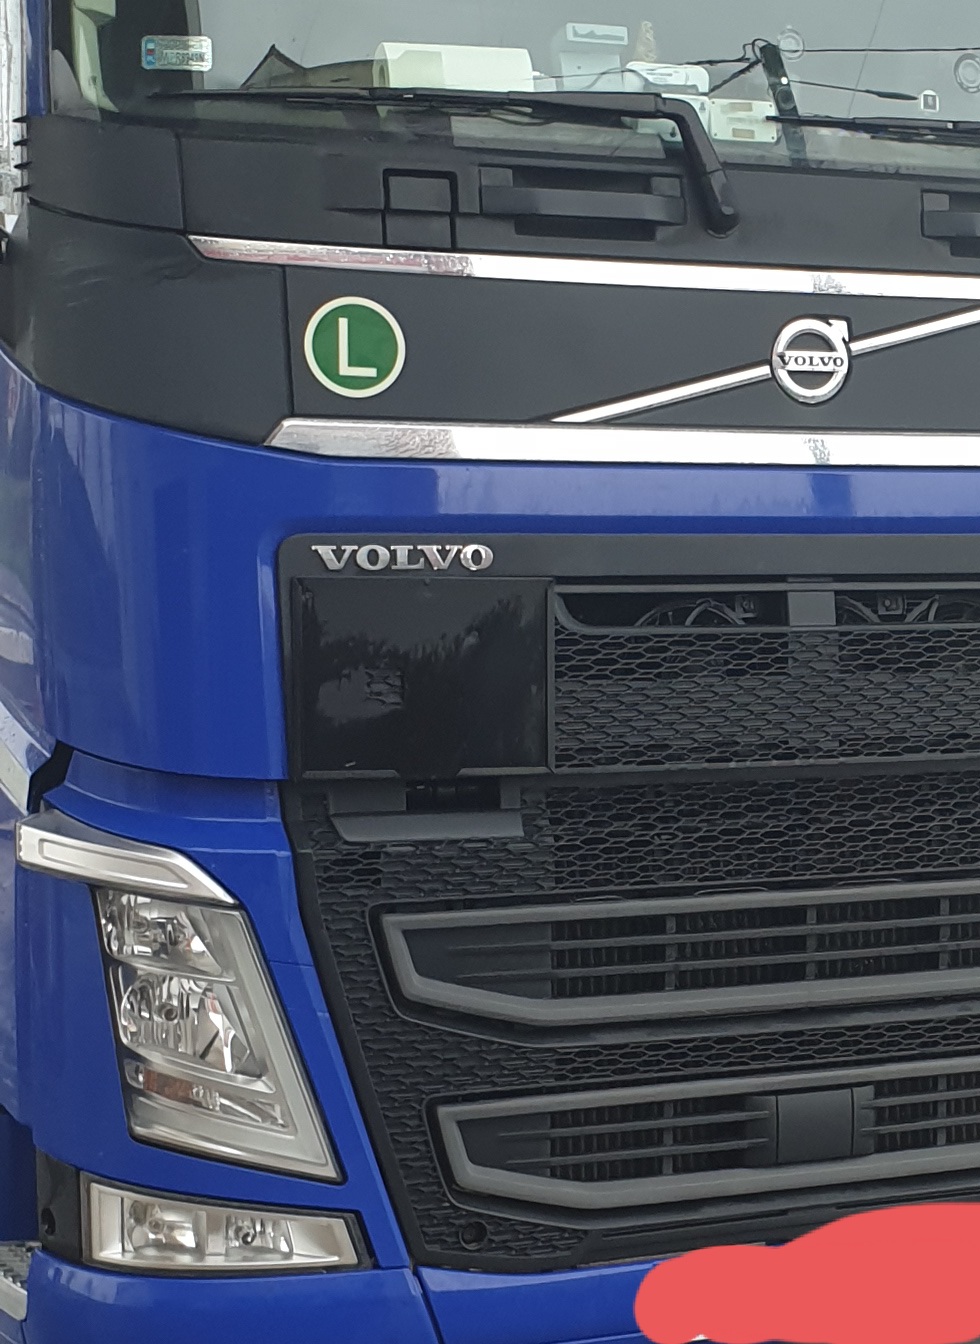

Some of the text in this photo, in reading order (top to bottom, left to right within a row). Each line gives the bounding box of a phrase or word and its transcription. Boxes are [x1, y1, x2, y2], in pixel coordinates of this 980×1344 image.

[338, 317, 378, 378] L
[777, 352, 845, 368] VOLVO
[311, 544, 494, 571] VOLVO
